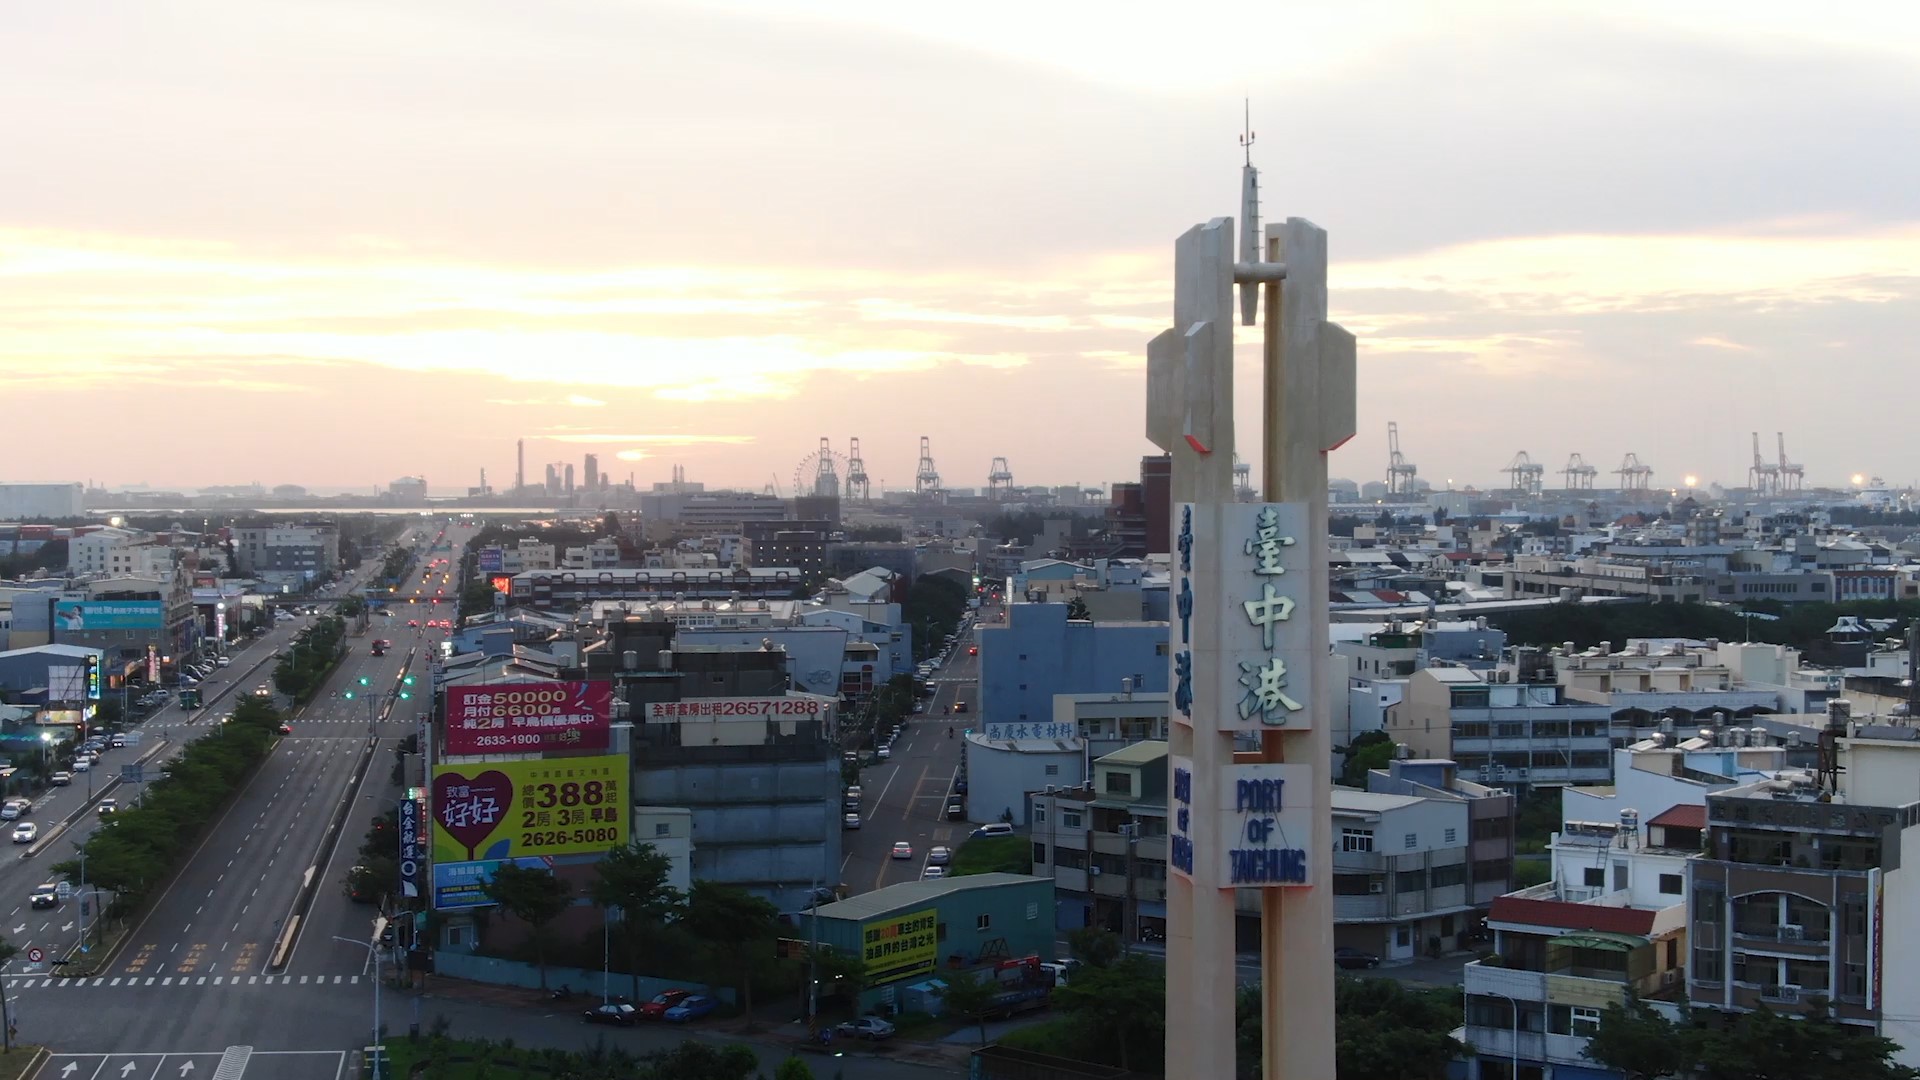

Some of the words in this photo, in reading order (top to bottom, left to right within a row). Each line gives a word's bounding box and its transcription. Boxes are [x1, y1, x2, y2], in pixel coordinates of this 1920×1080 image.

[1237, 506, 1304, 725] 臺中港
[463, 690, 567, 705] 訂金50000
[512, 714, 595, 727] 早鳥價優惠中
[476, 734, 541, 747] 2633-1900
[446, 785, 470, 799] 致富
[522, 784, 535, 809] 總價
[536, 780, 604, 808] 388
[1237, 778, 1285, 814] PORT
[443, 796, 500, 828] 好好
[522, 811, 551, 829] 2房
[557, 809, 585, 827] 3房
[590, 807, 618, 824] 早鳥
[402, 801, 416, 859] 台金航運
[521, 827, 618, 848] 2626-5080
[1247, 818, 1275, 843] OF
[1229, 848, 1306, 884] TAICHUNG
